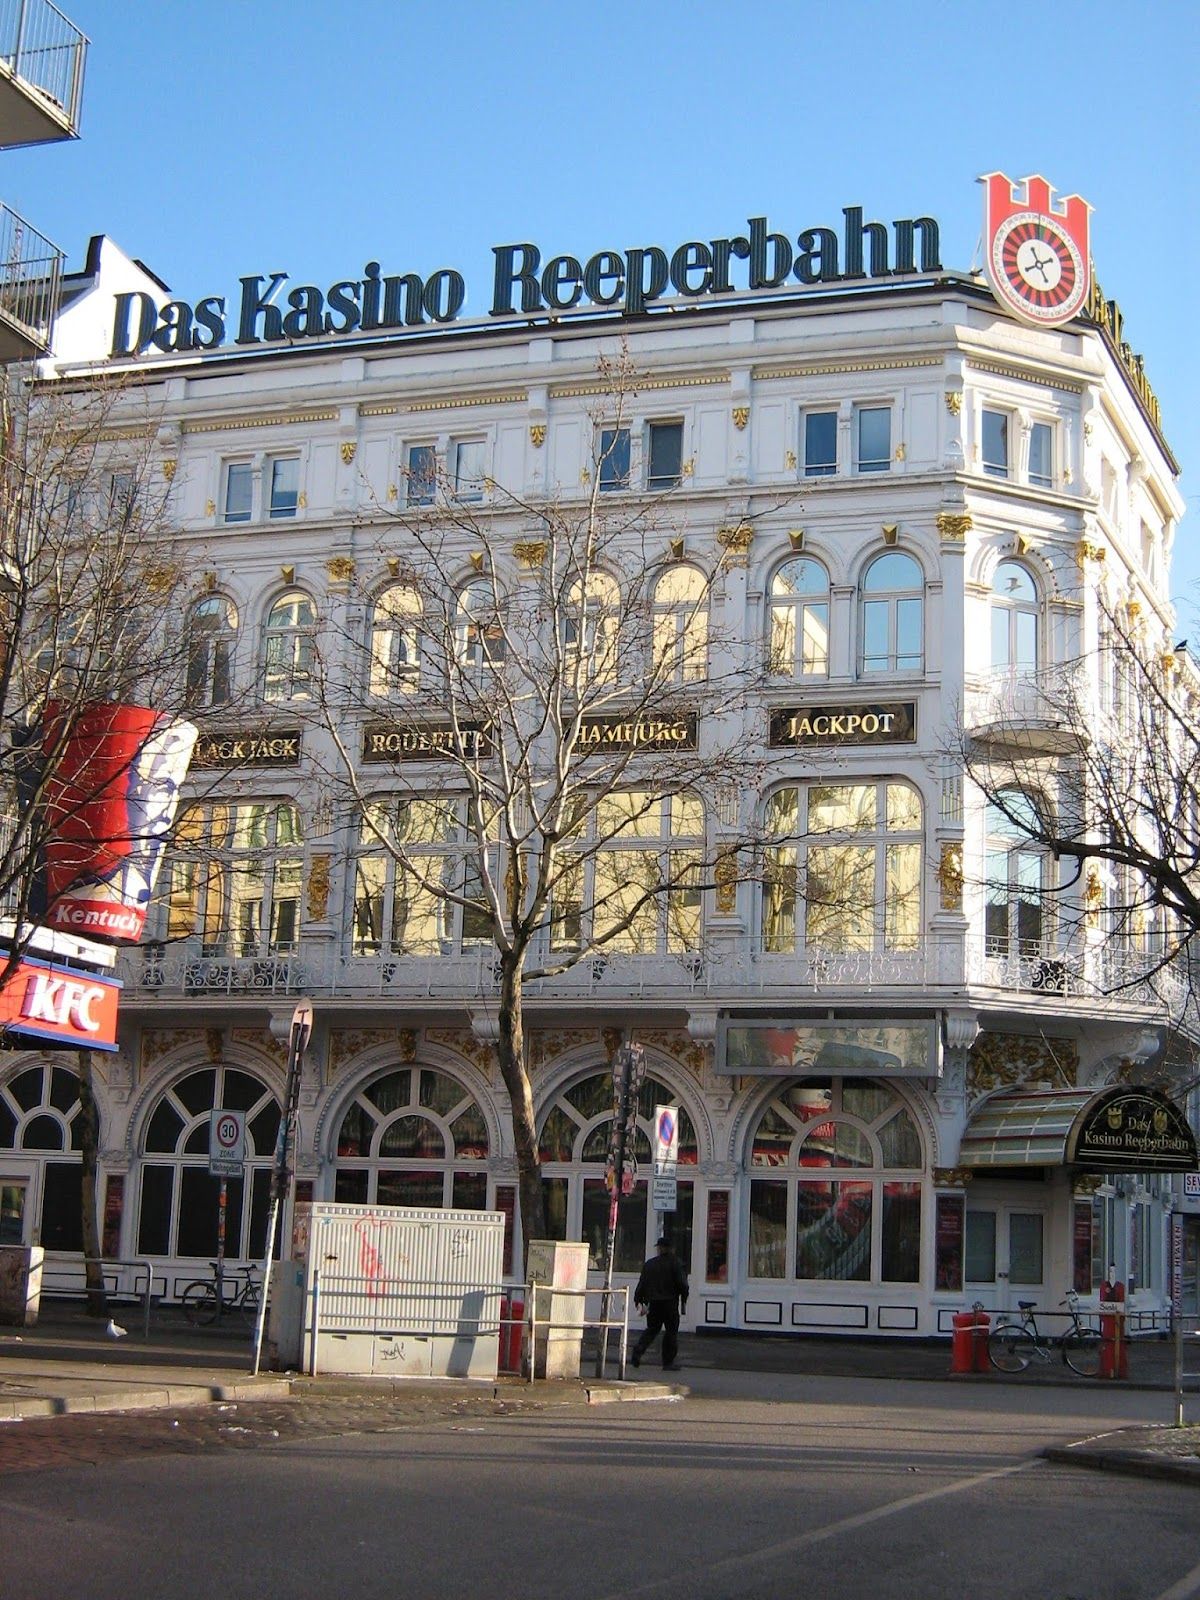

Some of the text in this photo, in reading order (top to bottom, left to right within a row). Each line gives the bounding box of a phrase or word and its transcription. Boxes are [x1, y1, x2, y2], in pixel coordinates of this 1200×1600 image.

[107, 292, 226, 358] Das
[235, 261, 465, 345] Kasino
[488, 206, 944, 314] Reeperbahn
[788, 713, 895, 738] JACKPOT
[248, 738, 298, 760] JACK
[24, 974, 105, 1032] KFC
[222, 1124, 235, 1138] 30
[1128, 1116, 1149, 1131] Das
[1085, 1131, 1189, 1152] Kasino Reeperbahn
